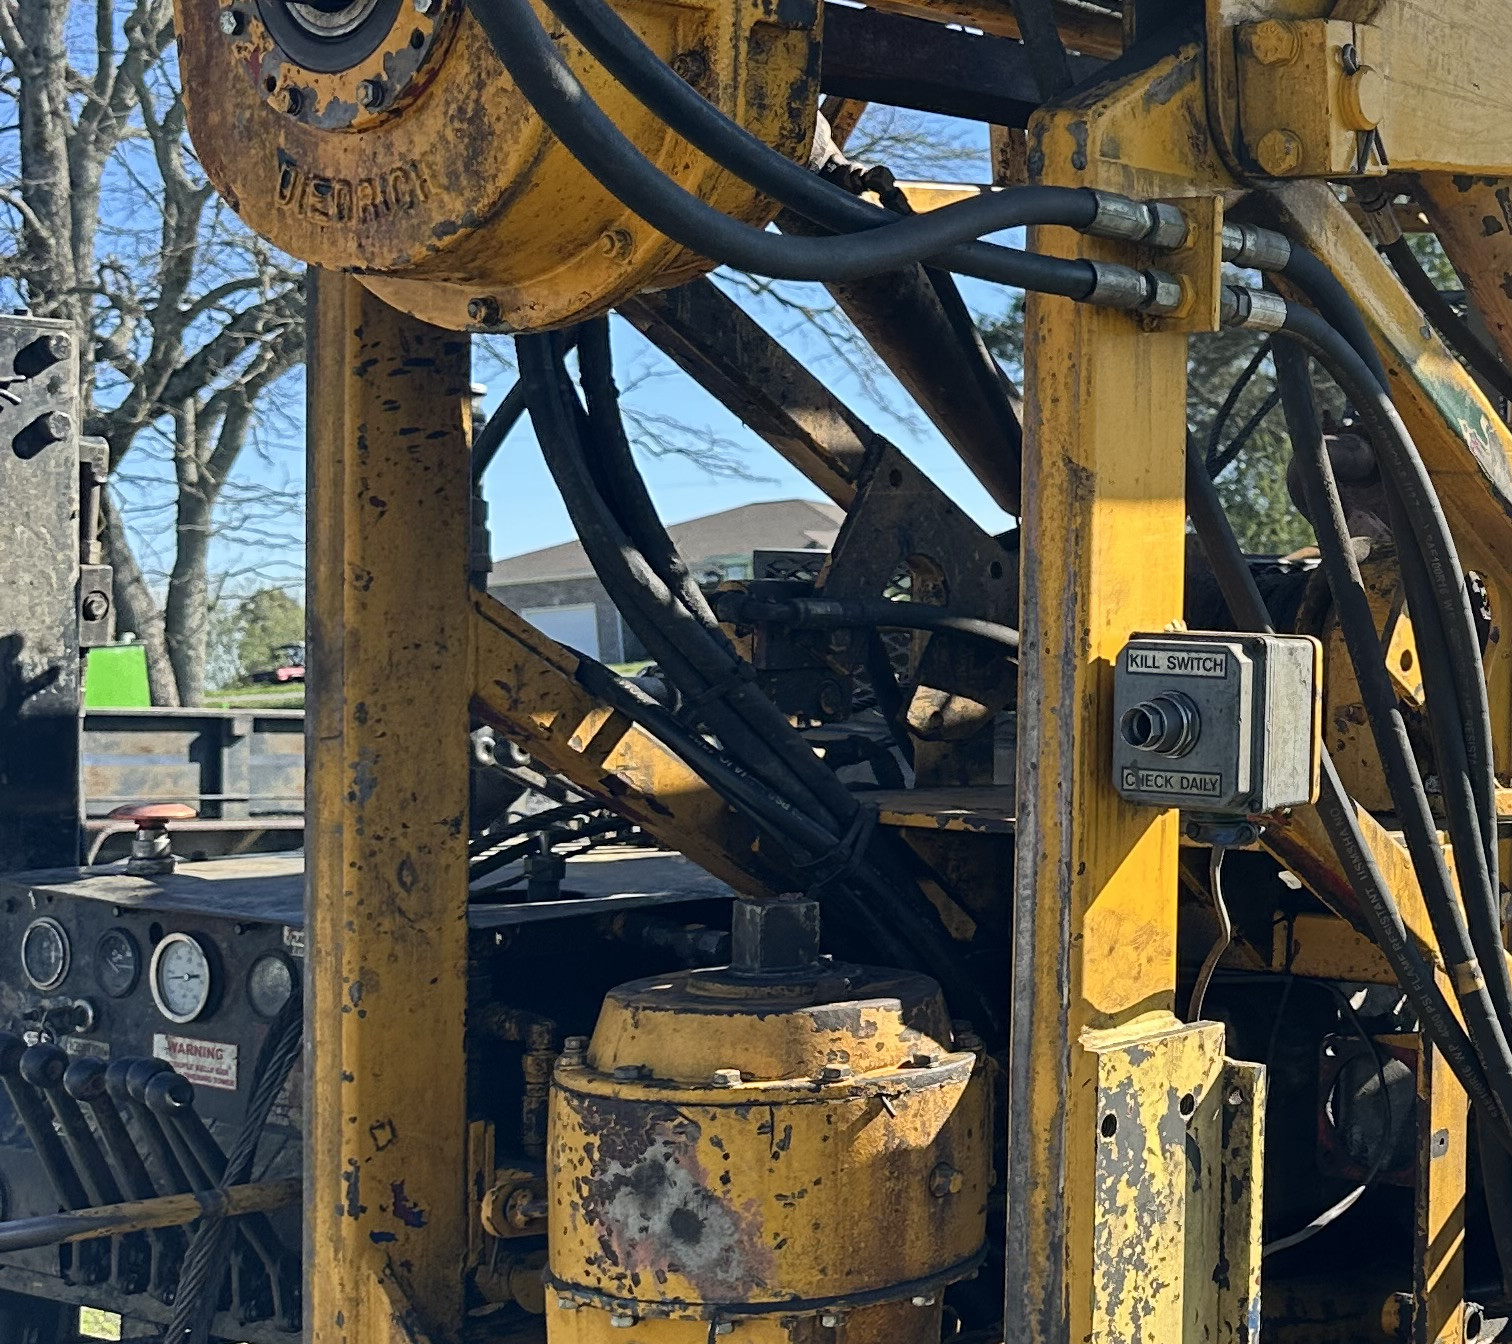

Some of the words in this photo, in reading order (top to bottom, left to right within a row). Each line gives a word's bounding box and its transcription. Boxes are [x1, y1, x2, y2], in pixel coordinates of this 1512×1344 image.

[1130, 654, 1160, 669] KILL
[1167, 655, 1223, 672] SWITCH
[1181, 776, 1219, 791] DAILY
[1362, 883, 1404, 951] RESISTANT
[1396, 950, 1424, 991] FLAME
[1418, 992, 1436, 1014] PSI
[1430, 1012, 1450, 1039] 4000
[168, 1041, 224, 1060] WARNING
